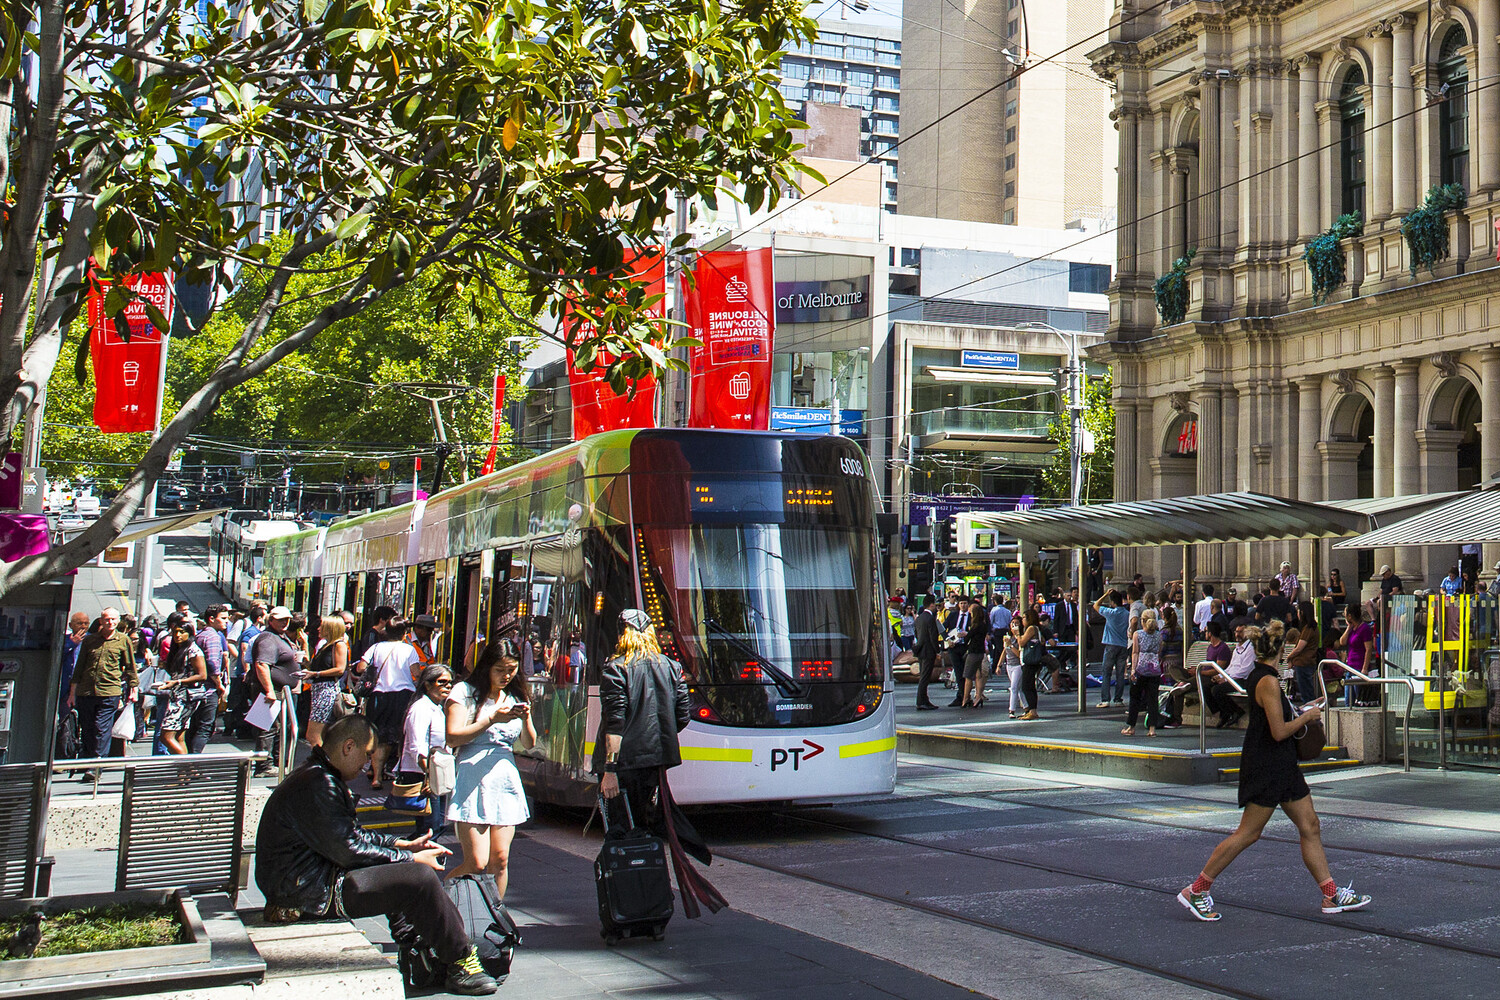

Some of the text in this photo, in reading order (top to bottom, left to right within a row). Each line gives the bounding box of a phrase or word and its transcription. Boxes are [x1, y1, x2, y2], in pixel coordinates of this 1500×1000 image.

[778, 291, 862, 309] of Melbourne
[840, 457, 864, 477] 6008
